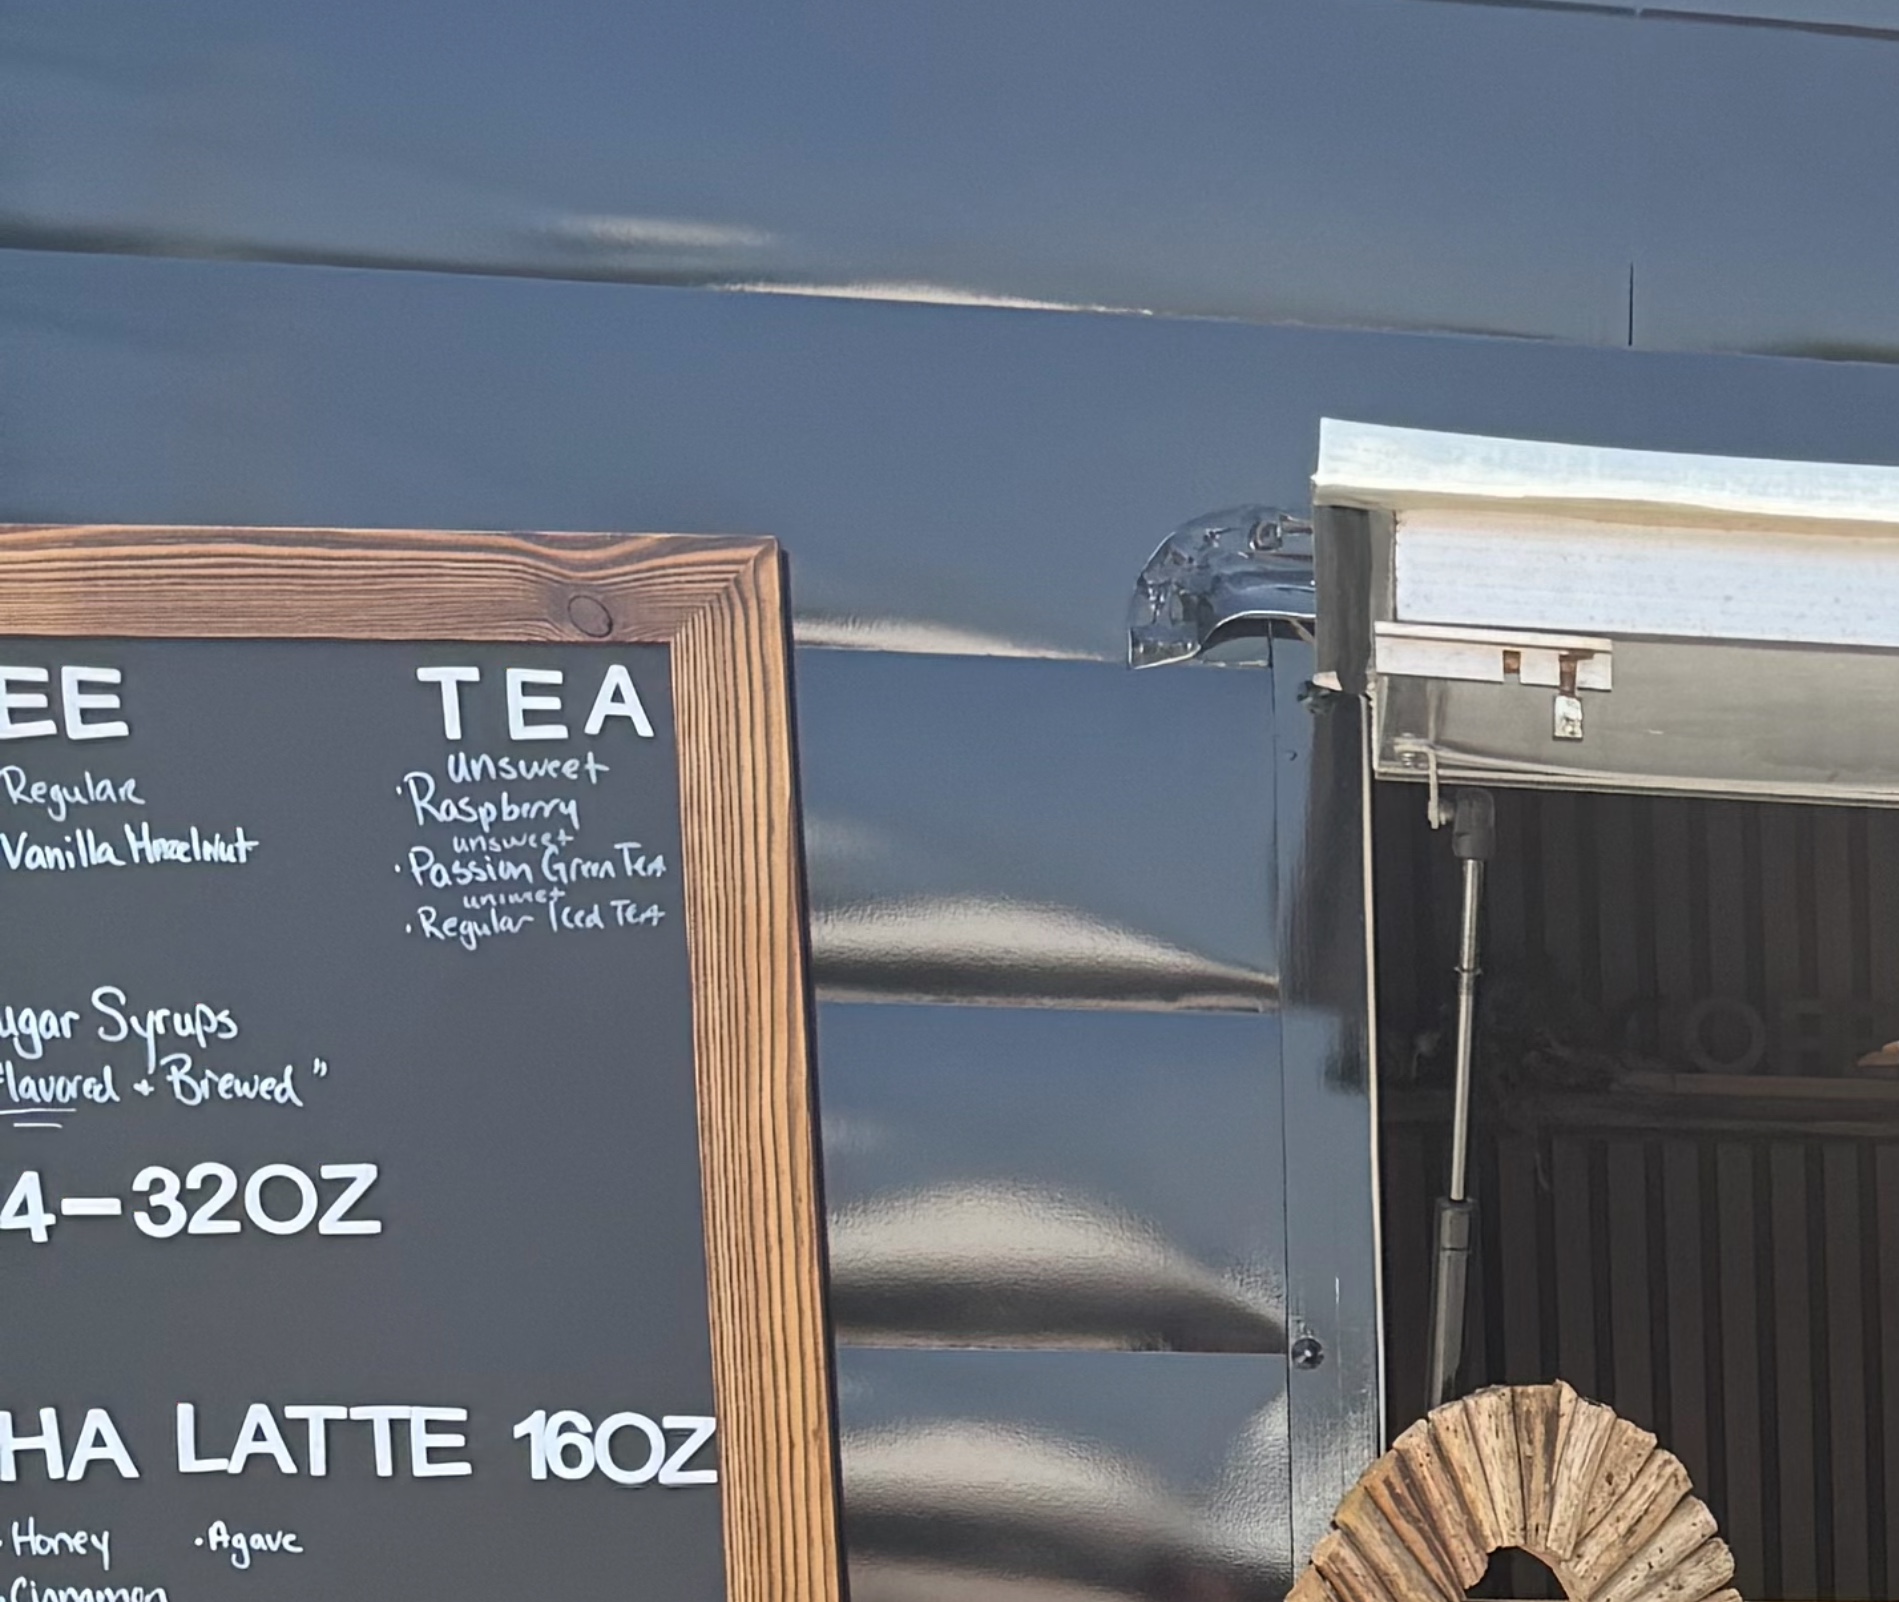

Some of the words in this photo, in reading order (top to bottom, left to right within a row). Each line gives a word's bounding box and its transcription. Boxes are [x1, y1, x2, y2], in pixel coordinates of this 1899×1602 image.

[416, 664, 656, 741] TEA
[91, 985, 239, 1075] Syrups
[0, 1060, 120, 1102] lavored
[175, 1403, 473, 1478] LATTE
[513, 1409, 719, 1487] 16OZ
[12, 1517, 112, 1570] Honey
[208, 1521, 305, 1570] Agave
